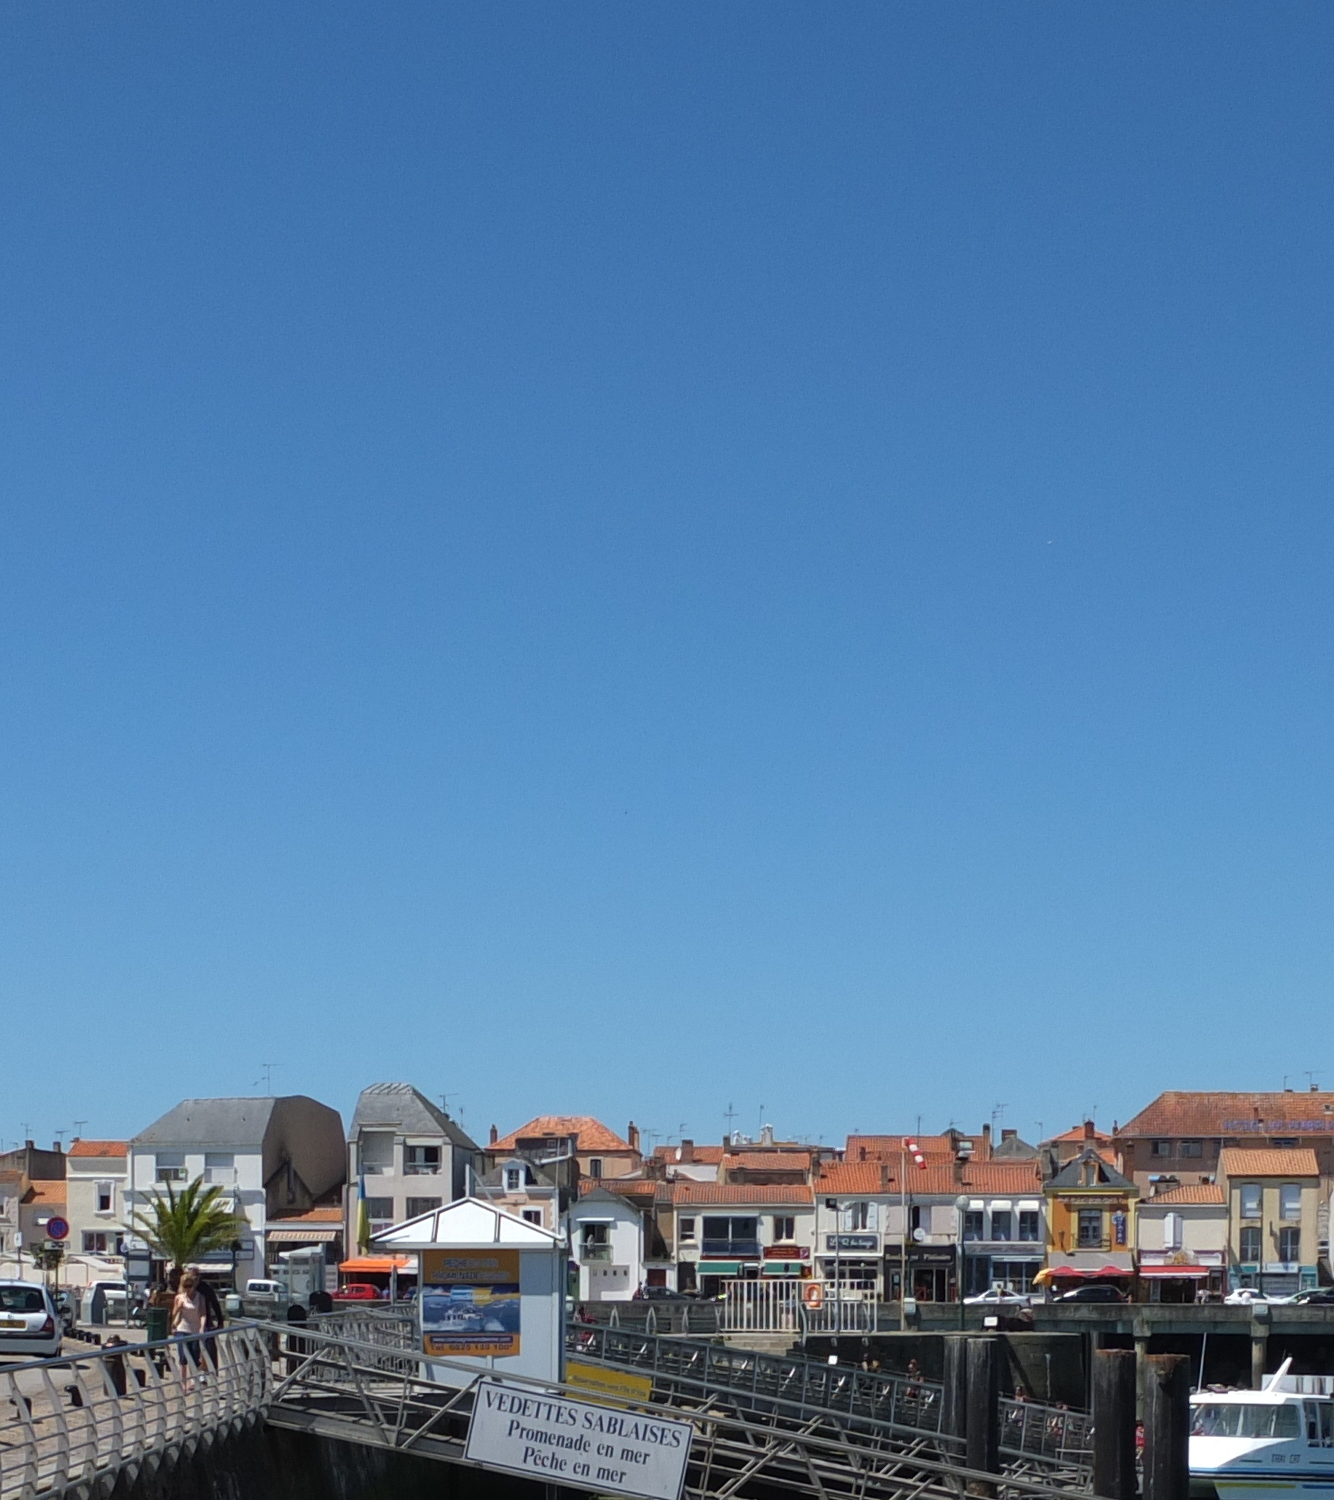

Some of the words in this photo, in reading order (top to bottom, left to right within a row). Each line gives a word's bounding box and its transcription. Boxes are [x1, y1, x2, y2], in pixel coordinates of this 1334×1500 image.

[485, 1390, 577, 1426] VEDETTES
[582, 1411, 682, 1448] SABLAISES
[507, 1419, 591, 1453] Promenade
[597, 1443, 614, 1458] en
[620, 1447, 651, 1465] mer
[523, 1446, 567, 1472] Pêche
[573, 1462, 590, 1476] en
[596, 1467, 627, 1484] mer
